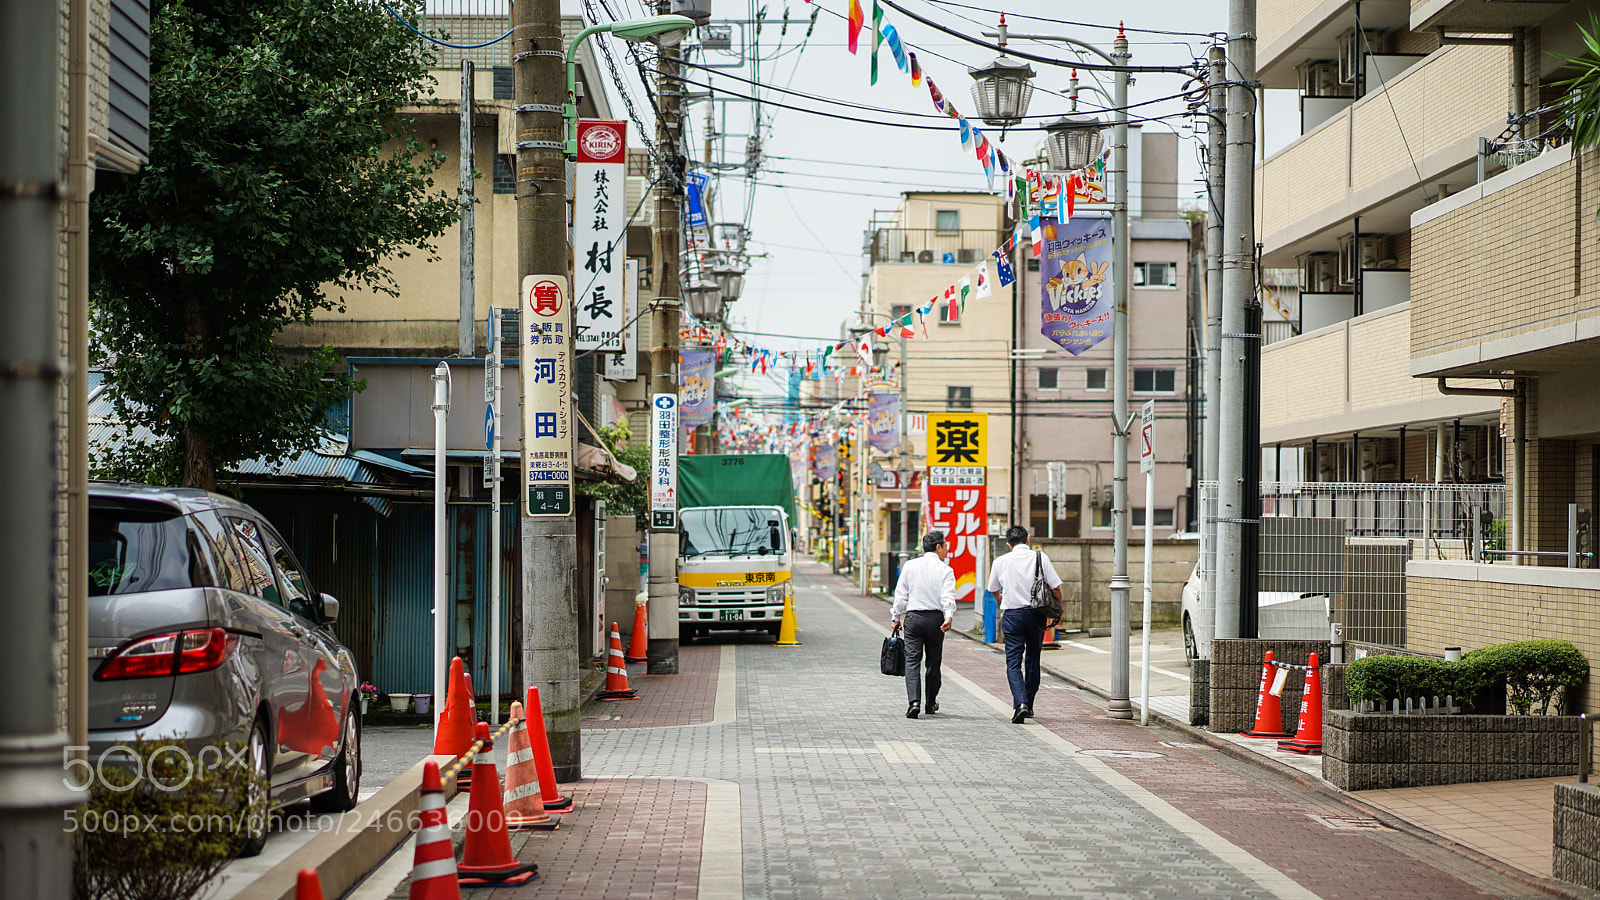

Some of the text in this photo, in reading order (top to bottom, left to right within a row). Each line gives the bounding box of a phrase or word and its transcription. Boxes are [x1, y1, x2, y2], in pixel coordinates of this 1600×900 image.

[589, 141, 614, 149] KIRIN
[591, 169, 610, 232] 株式会社
[1046, 228, 1107, 253] 羽田ヴィッキーズ
[584, 240, 614, 320] 村長
[533, 285, 558, 315] 質
[1048, 284, 1103, 312] Vickies
[534, 358, 558, 438] 河田
[557, 351, 568, 440] ディスカウント・ショップ
[658, 410, 671, 486] 羽田整形形成外科
[936, 420, 979, 463] 薬
[530, 471, 568, 480] 3741-0004
[721, 457, 745, 466] 3776
[536, 491, 563, 500] 羽田
[540, 502, 560, 510] 4-4
[954, 489, 981, 558] ツルハ
[745, 572, 775, 583] 東京南
